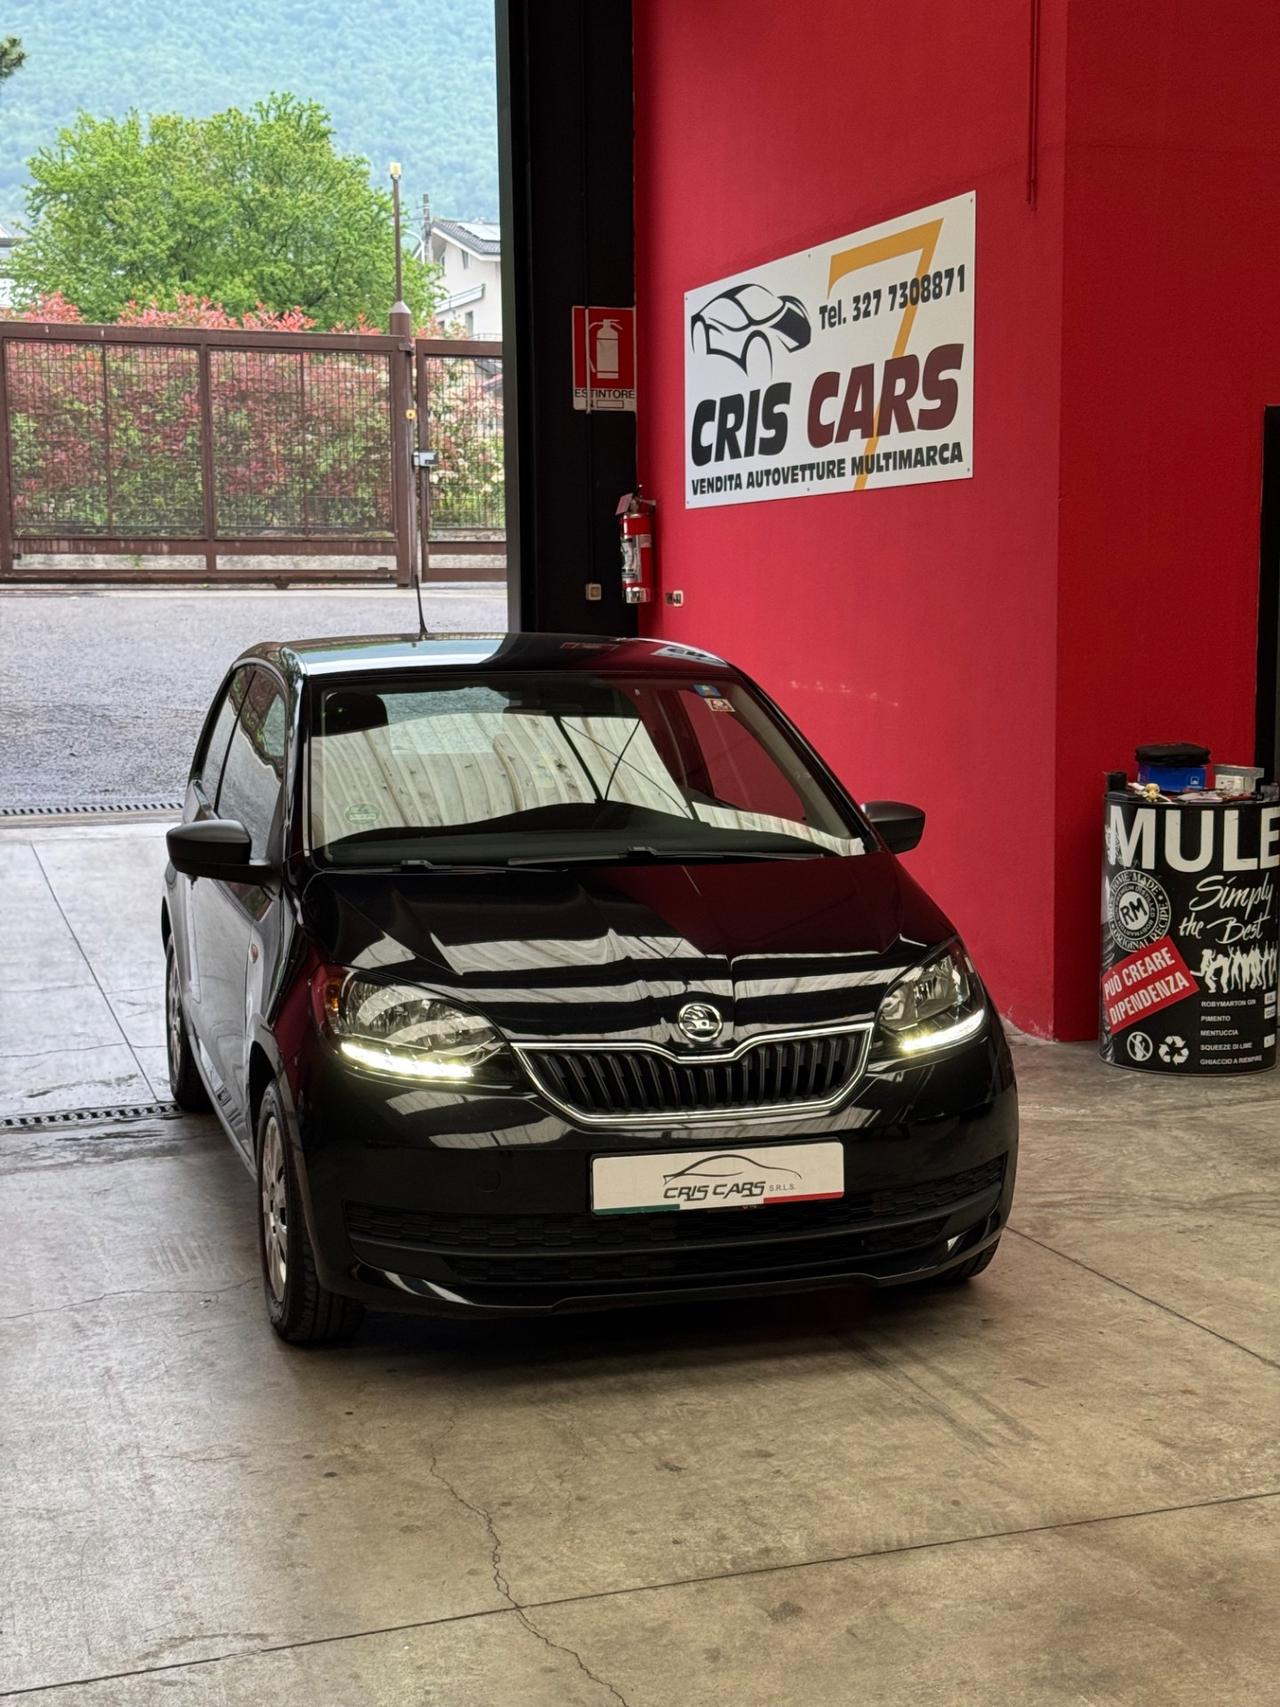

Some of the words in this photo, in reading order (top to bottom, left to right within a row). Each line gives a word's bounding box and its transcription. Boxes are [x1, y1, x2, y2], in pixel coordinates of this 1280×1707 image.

[819, 299, 847, 330] Tel.
[852, 289, 882, 321] 327
[888, 264, 965, 312] 7308871
[574, 389, 635, 399] ESTINTORE
[691, 382, 792, 467] CRIS
[807, 343, 964, 449] CARS
[692, 473, 742, 496] VENDITA
[746, 458, 846, 489] AUTOVETTURE
[851, 441, 963, 476] MULTIMARCA
[1132, 873, 1159, 896] MADE
[1189, 872, 1274, 920] Simply
[1120, 898, 1148, 926] RM
[1179, 913, 1204, 939] the
[1206, 914, 1271, 944] Best
[1104, 971, 1122, 1000] PUÒ
[1122, 947, 1175, 986] CREARE
[1109, 971, 1190, 1025] DIPENDENZA
[663, 1185, 709, 1201] CRIS
[712, 1181, 766, 1199] CARS
